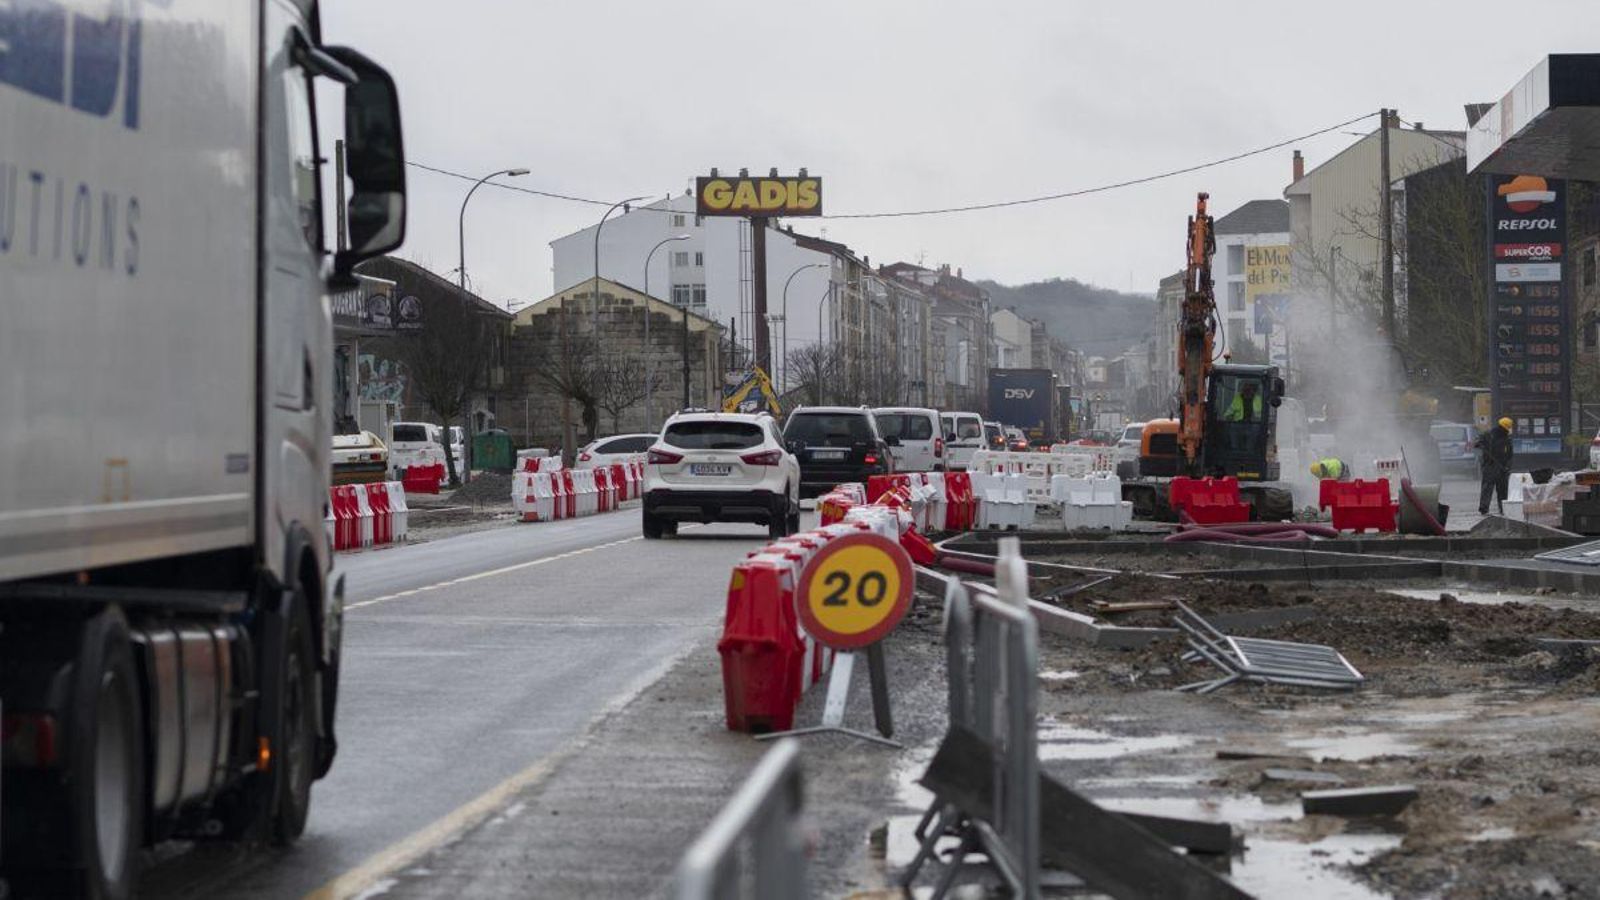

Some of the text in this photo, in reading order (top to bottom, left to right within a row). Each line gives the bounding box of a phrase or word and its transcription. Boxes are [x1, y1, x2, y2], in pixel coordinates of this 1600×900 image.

[703, 179, 819, 210] GADIS
[1498, 218, 1557, 231] REPSOL
[1004, 388, 1035, 400] DSV
[823, 570, 887, 607] 20
